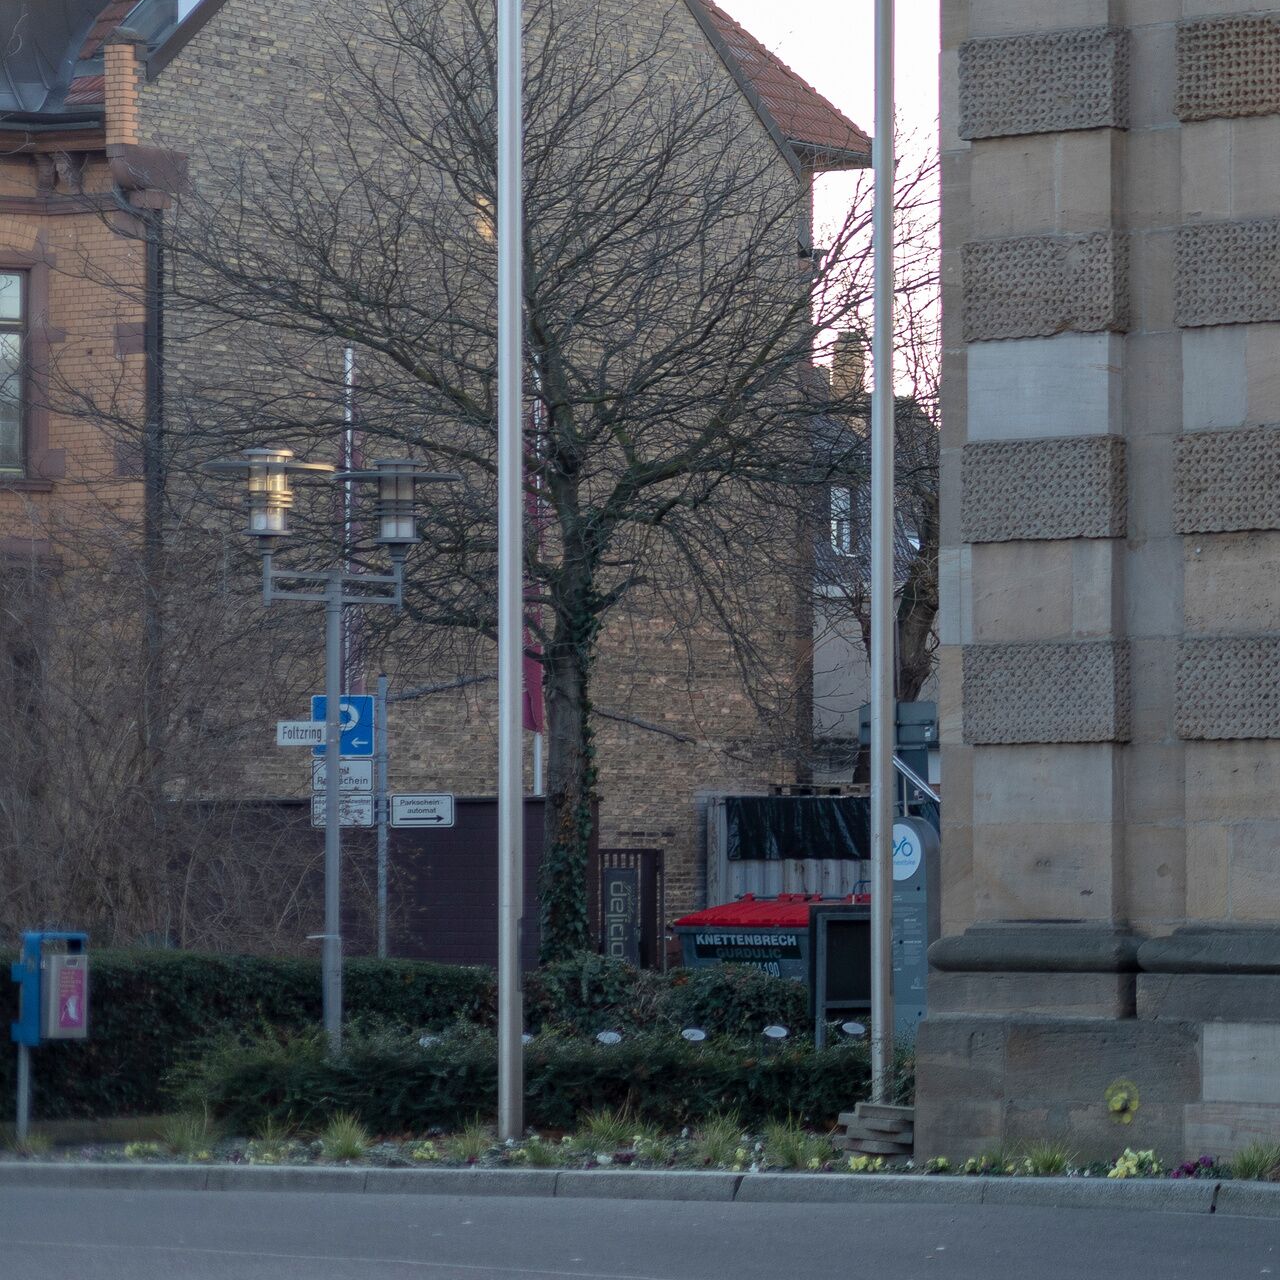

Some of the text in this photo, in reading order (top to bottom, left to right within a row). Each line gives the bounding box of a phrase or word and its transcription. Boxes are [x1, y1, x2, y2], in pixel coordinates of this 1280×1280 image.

[282, 726, 322, 742] Foltzring
[317, 776, 369, 785] Paschein
[696, 934, 797, 946] KNETTENBRECH
[716, 948, 782, 959] GURDULIC
